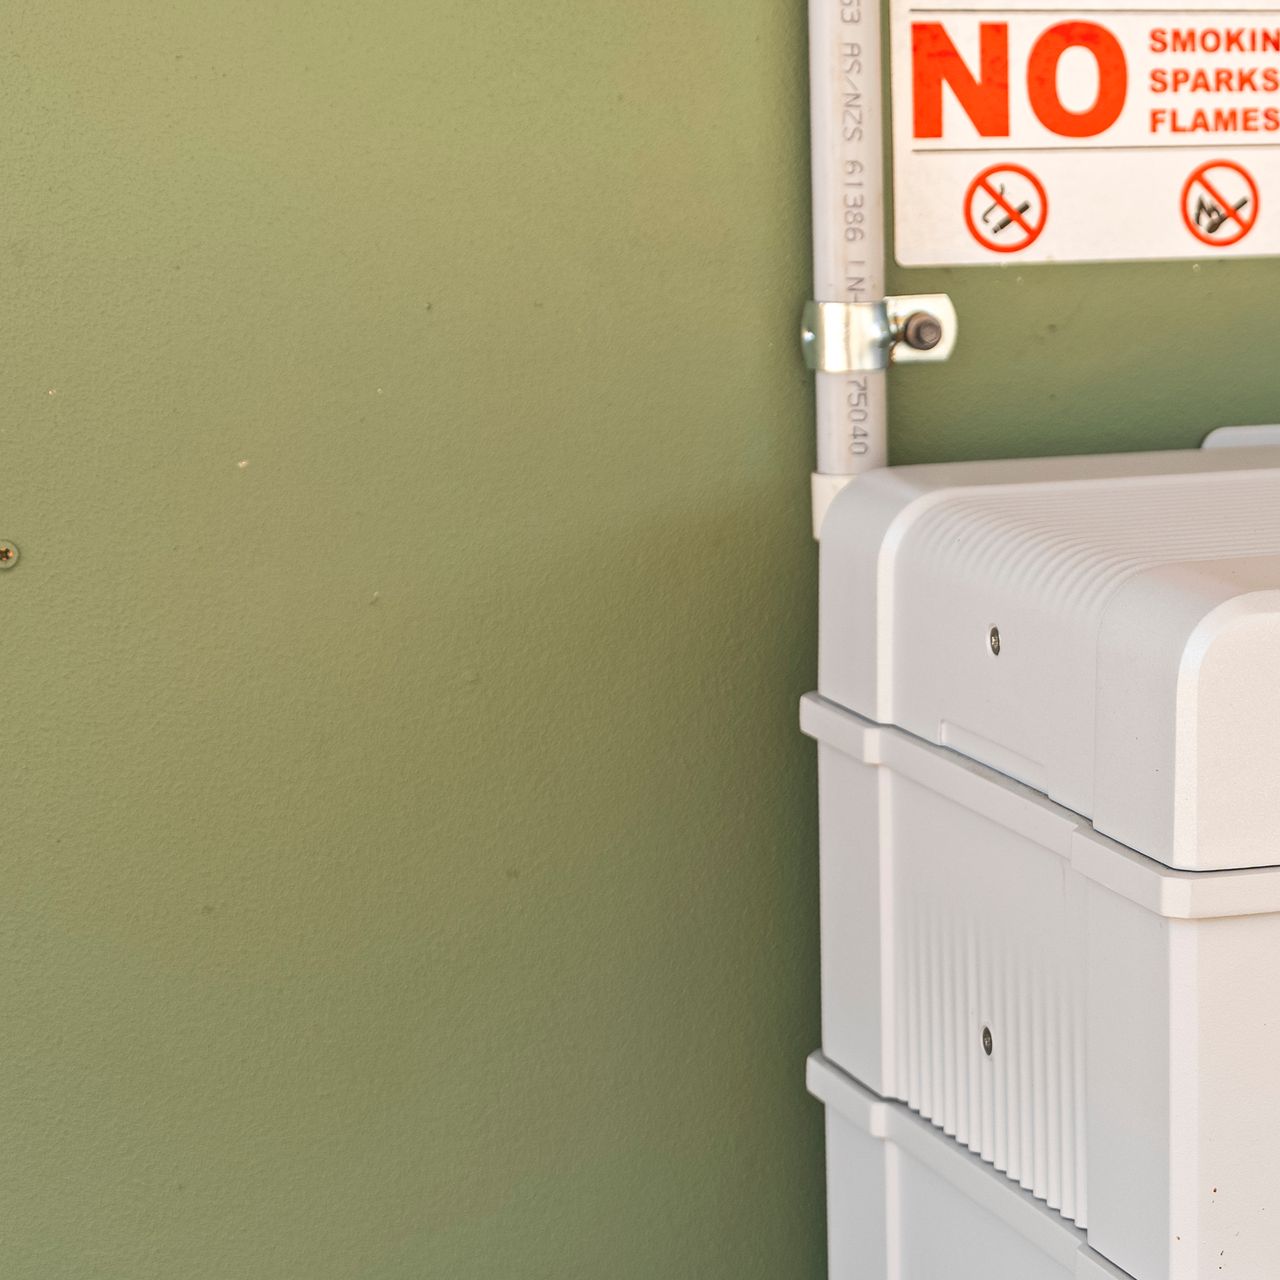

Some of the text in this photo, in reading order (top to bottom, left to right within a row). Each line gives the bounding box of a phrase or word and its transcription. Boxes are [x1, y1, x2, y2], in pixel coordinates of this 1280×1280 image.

[911, 19, 1128, 138] NO
[1149, 67, 1280, 93] SPARKS
[844, 160, 864, 242] 61386
